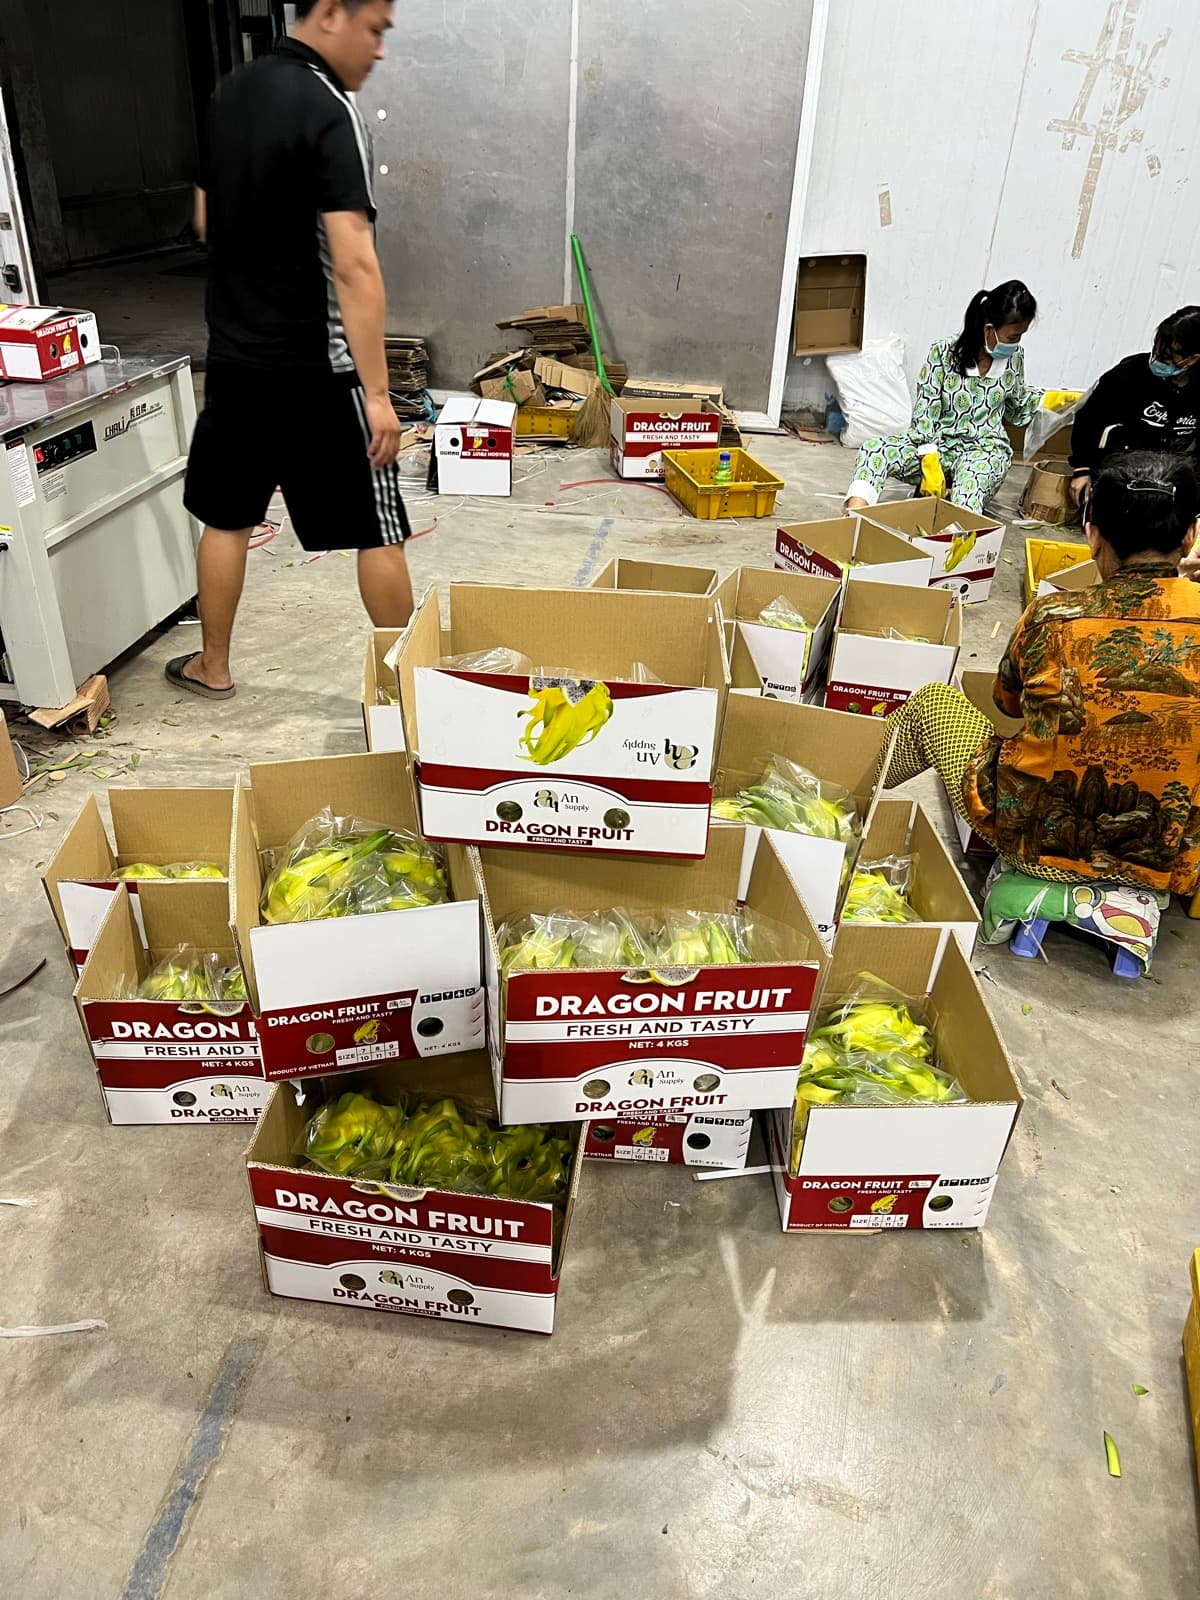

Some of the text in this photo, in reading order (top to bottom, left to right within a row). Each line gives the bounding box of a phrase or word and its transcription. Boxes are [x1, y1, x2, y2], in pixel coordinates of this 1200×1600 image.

[633, 421, 711, 432] DRAGON FRUIT
[780, 541, 811, 571] DRAGON
[832, 685, 867, 695] DRAGON
[867, 690, 892, 699] FRUIT
[622, 739, 656, 751] Supply
[637, 751, 661, 766] An
[560, 793, 579, 803] An
[564, 803, 590, 812] Supply
[485, 820, 635, 841] DRAGON FRUIT
[535, 987, 793, 1017] DRAGON FRUIT
[267, 1009, 335, 1027] DRAGON
[337, 1002, 381, 1018] FRUIT
[332, 1017, 354, 1025] FRESH
[372, 1011, 394, 1019] TASTY
[111, 1021, 240, 1039] DRAGON
[566, 1018, 756, 1037] FRESH AND TASTY
[144, 1046, 201, 1056] FRESH
[206, 1045, 245, 1056] AND
[628, 1041, 655, 1049] NET:
[666, 1039, 690, 1048] KGS
[337, 1053, 356, 1061] SIZE
[269, 1067, 298, 1076] PRODUCT
[308, 1061, 335, 1070] VIETNAM
[656, 1070, 675, 1079] An
[233, 1084, 251, 1093] An
[659, 1077, 685, 1086] Supply
[575, 1094, 729, 1113] DRAGON FRUIT
[170, 1108, 248, 1118] DRAGON
[802, 1180, 904, 1190] DRAGON FRUIT
[275, 1188, 525, 1238] DRAGON FRUIT
[309, 1219, 493, 1253] FRESH AND TASTY
[371, 1244, 397, 1254] NET:
[408, 1248, 432, 1258] KGS
[405, 1274, 424, 1284] An
[409, 1283, 435, 1292] Supply
[332, 1287, 482, 1316] DRAGON FRUIT
